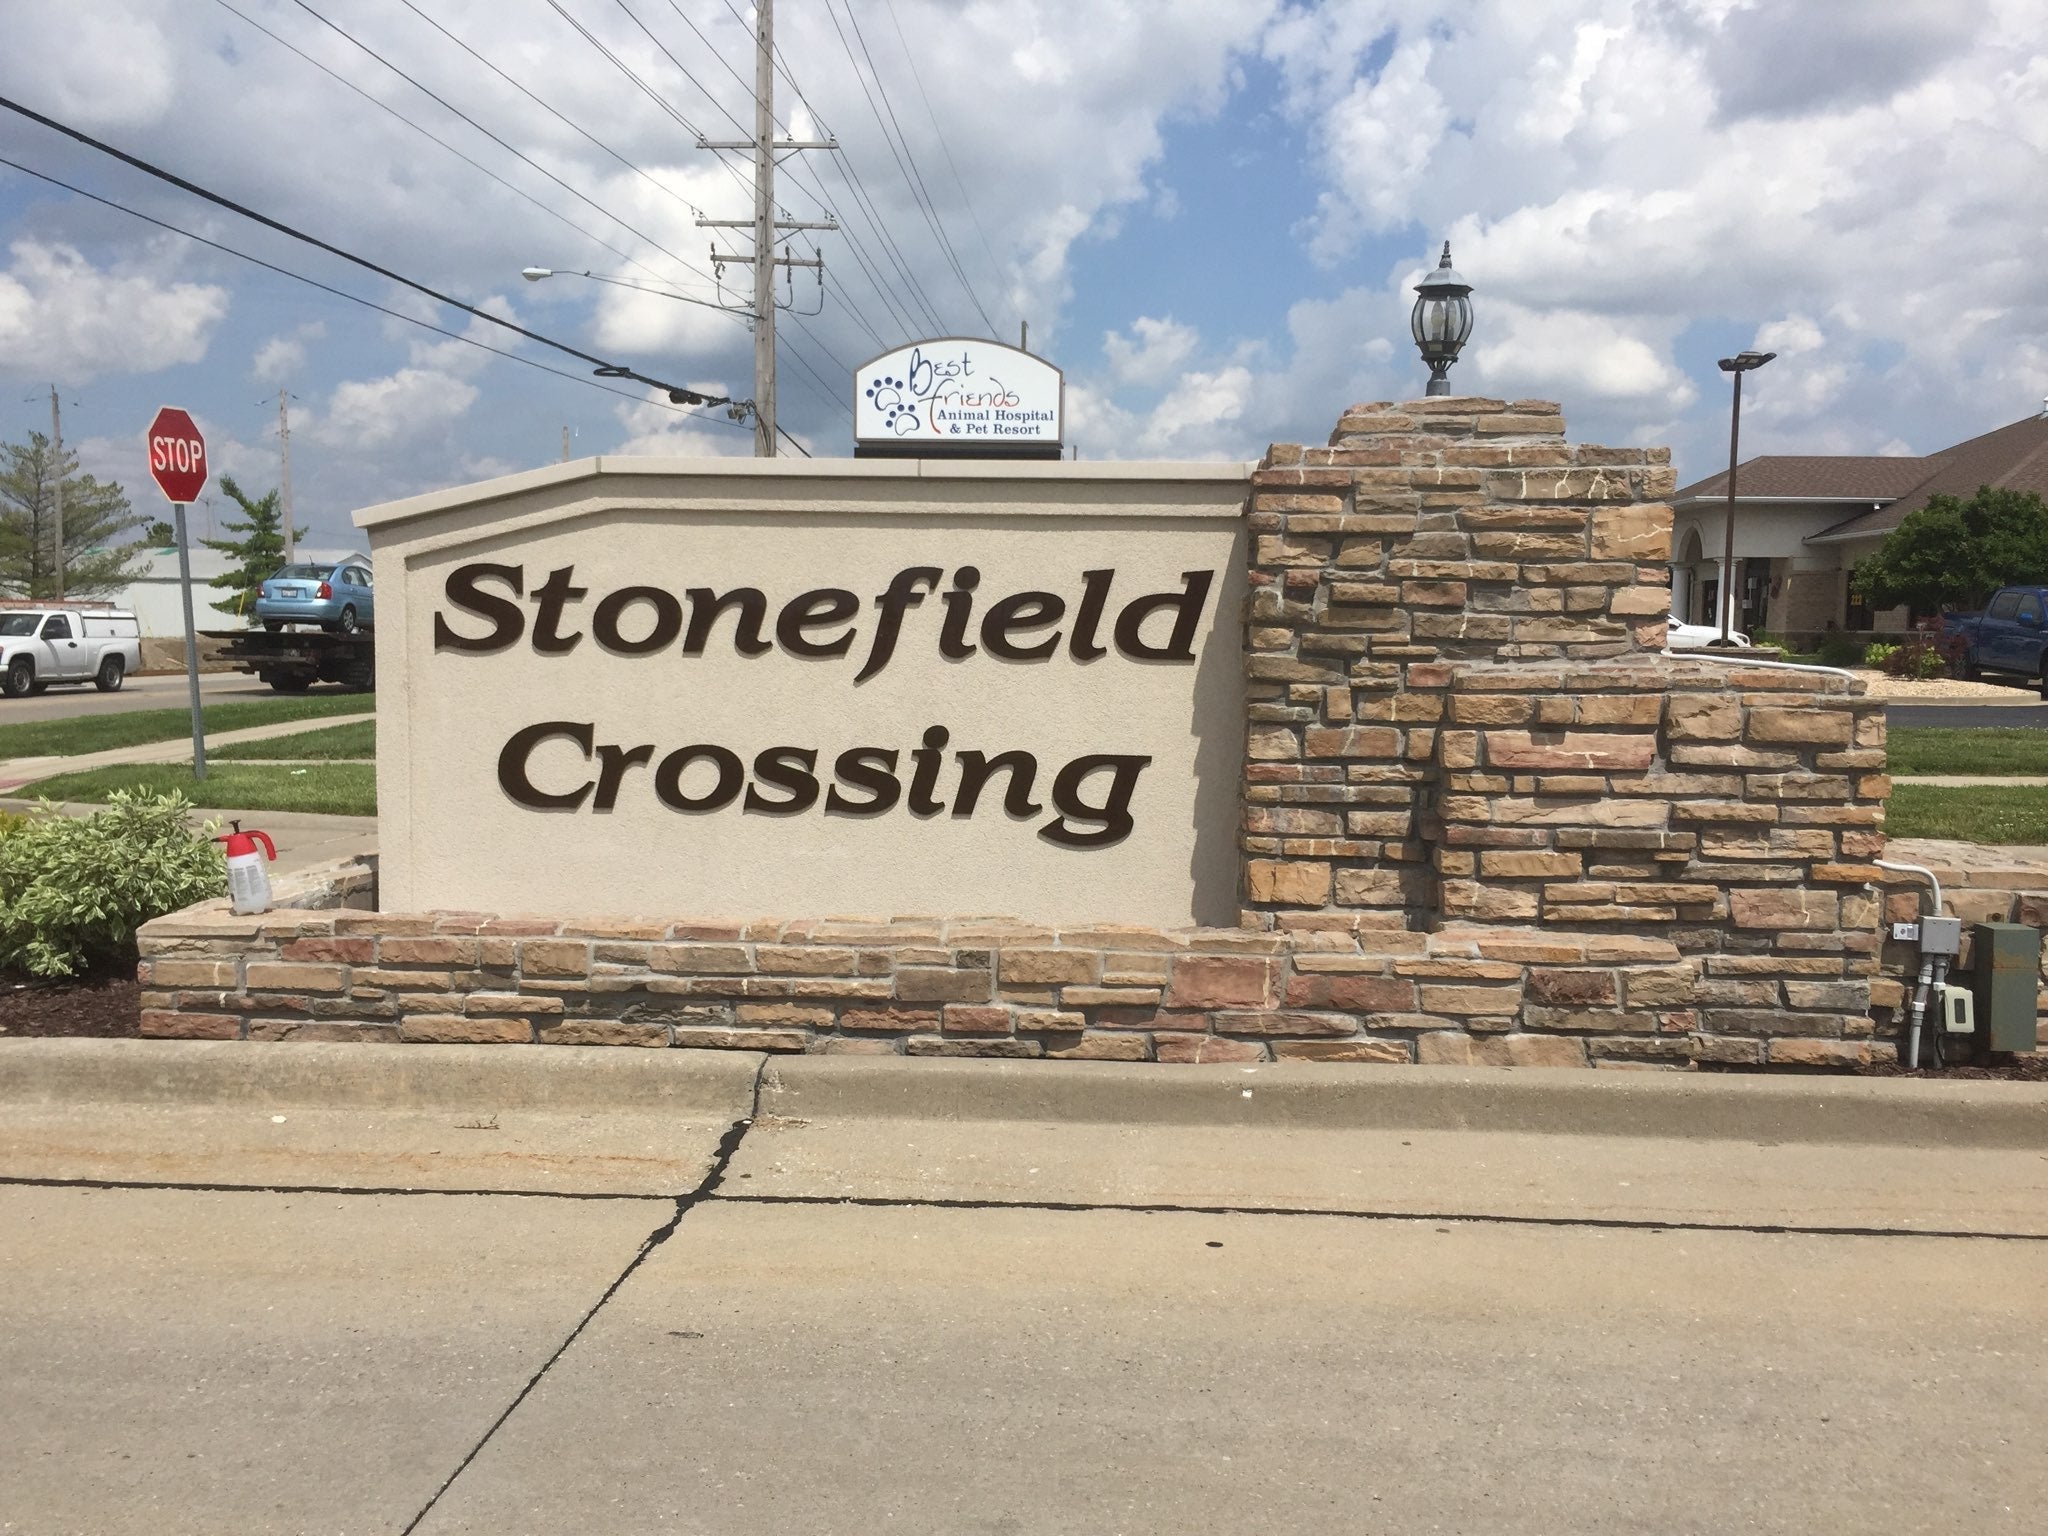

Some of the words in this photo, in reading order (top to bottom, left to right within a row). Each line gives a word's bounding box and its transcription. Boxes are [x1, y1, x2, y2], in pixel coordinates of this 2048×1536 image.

[937, 409, 990, 421] Animal
[995, 410, 1054, 422] Hospital
[949, 423, 961, 434] &
[966, 424, 988, 434] Pet
[993, 424, 1041, 435] Resort
[153, 436, 203, 473] STOP
[434, 563, 1215, 683] Stonefield
[497, 721, 1153, 848] Crossing
